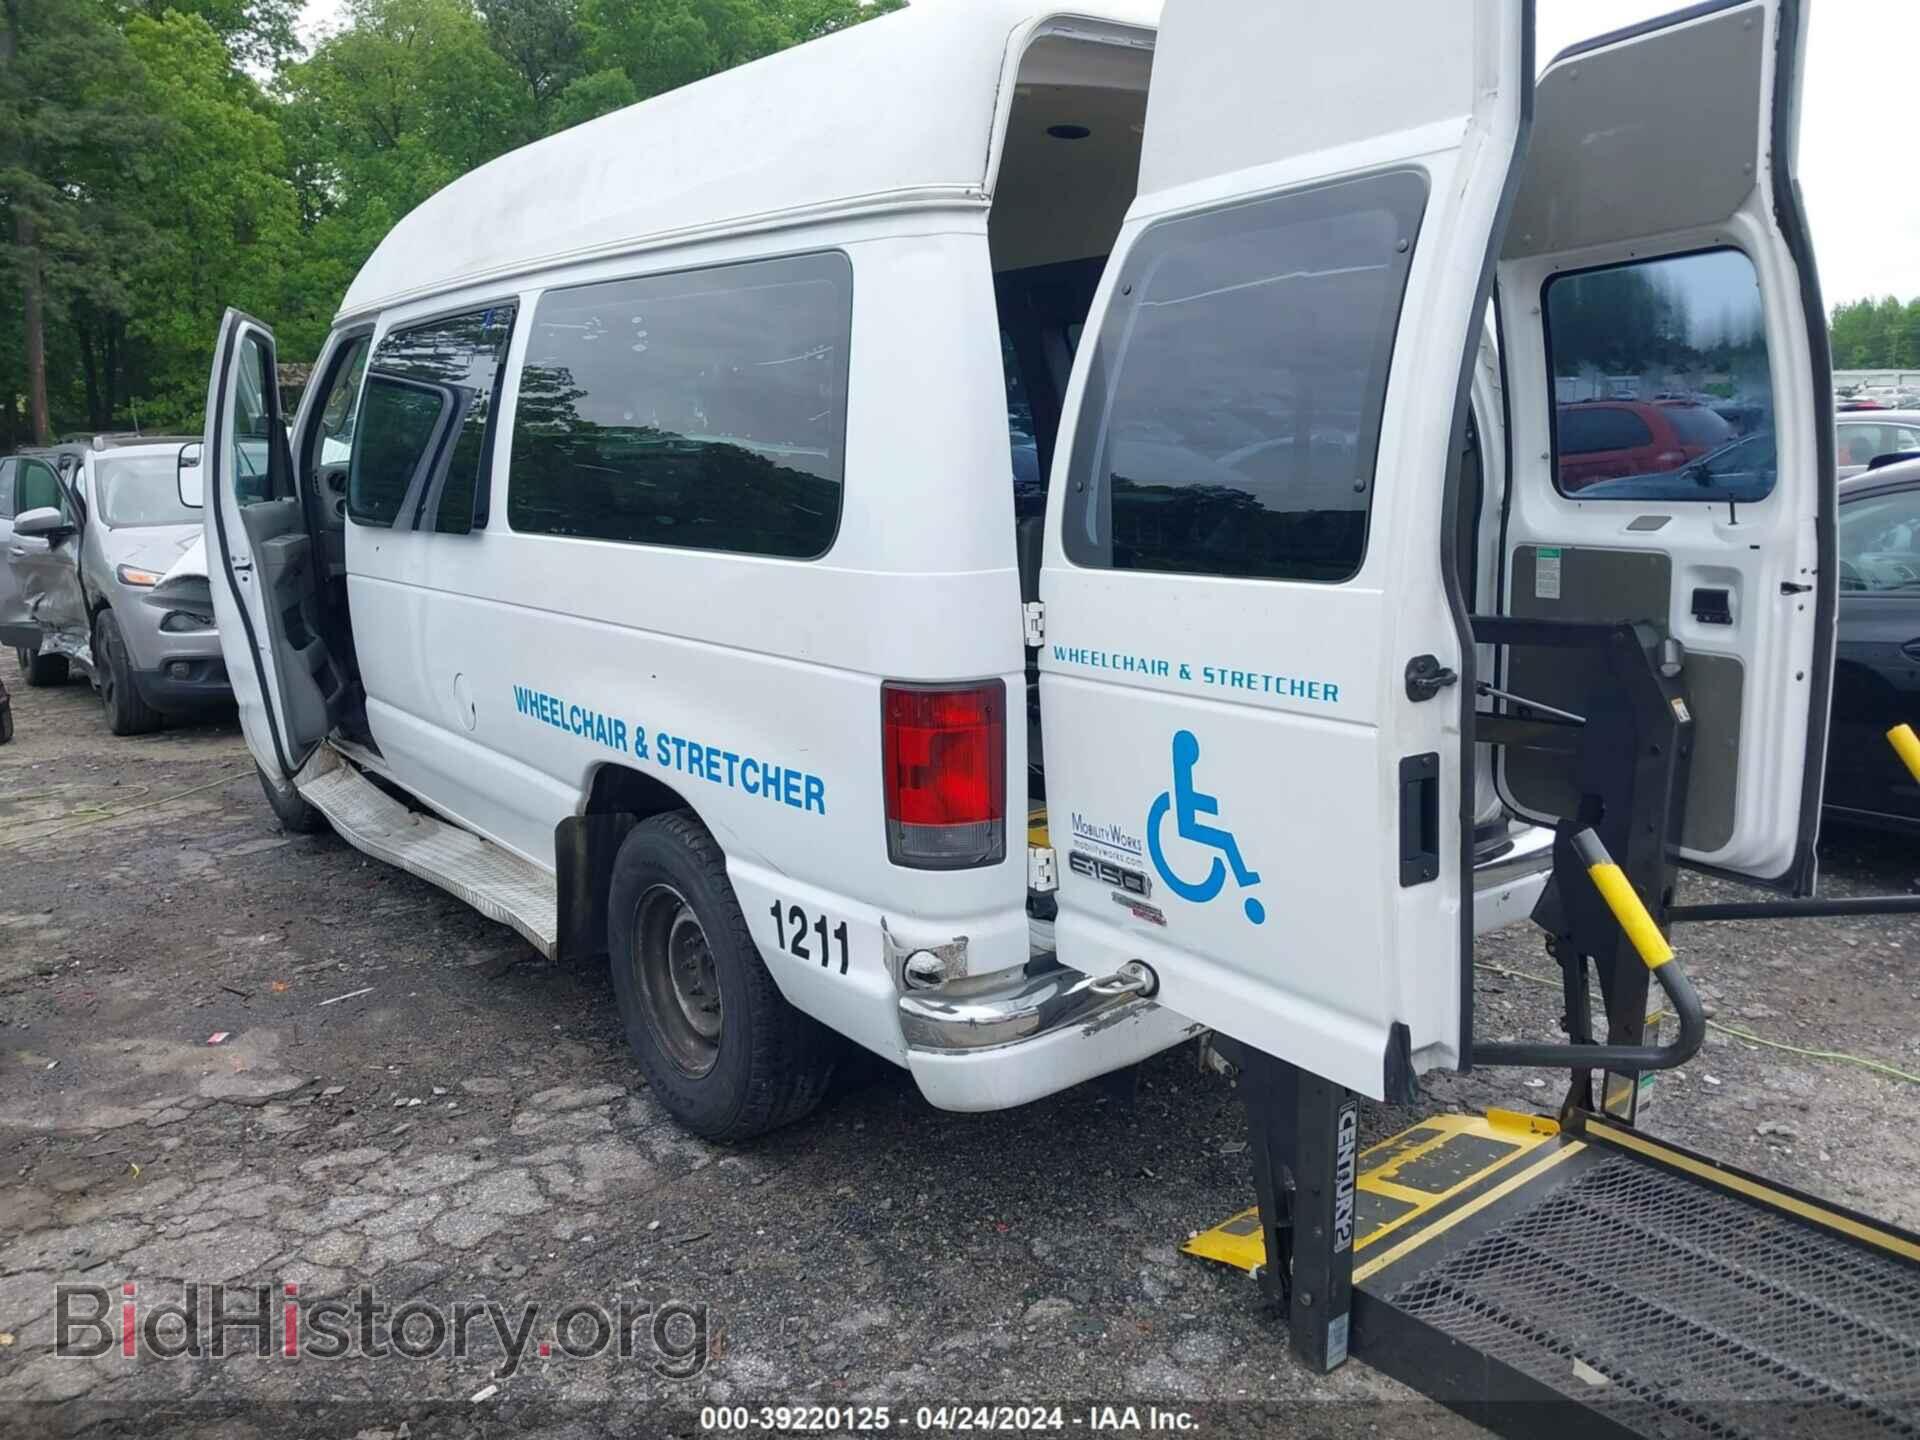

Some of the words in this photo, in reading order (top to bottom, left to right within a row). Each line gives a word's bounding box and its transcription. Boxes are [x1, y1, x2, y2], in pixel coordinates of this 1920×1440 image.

[1053, 646, 1169, 677] WHEELCHAIR
[1179, 664, 1192, 681] &
[1203, 667, 1340, 703] STRETCHER
[513, 685, 627, 752] WHEELCHAIR
[635, 726, 649, 760] &
[657, 733, 826, 815] STRETCHER
[770, 899, 849, 976] 1211
